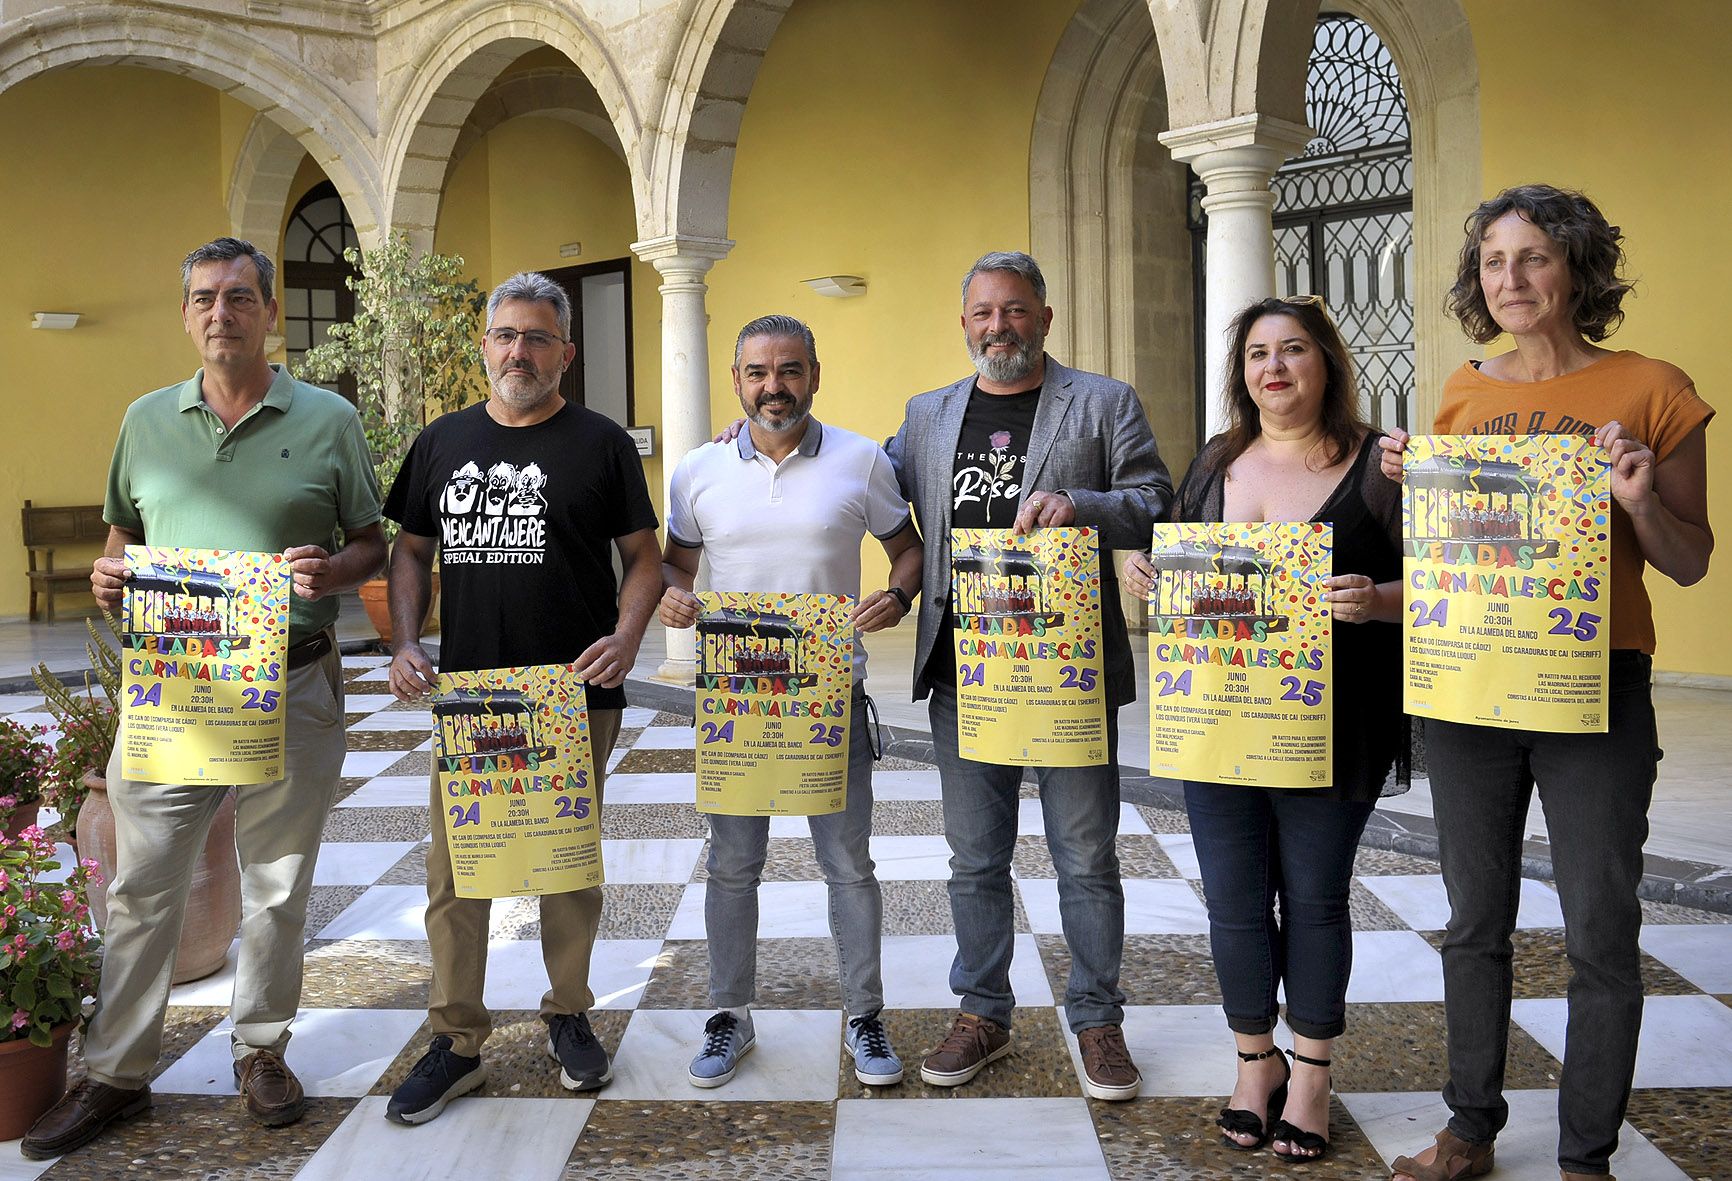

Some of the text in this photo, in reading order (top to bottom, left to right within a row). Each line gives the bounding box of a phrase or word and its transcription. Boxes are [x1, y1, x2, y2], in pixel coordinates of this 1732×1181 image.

[957, 452, 1027, 463] THE ROS
[953, 466, 1022, 510] Rise
[444, 552, 544, 564] SPECIAL EDITION
[1412, 541, 1535, 570] VELADAS
[1410, 569, 1601, 602] CARNAVALESCAS
[1409, 598, 1449, 629] 24
[1487, 602, 1509, 614] JUNIO
[959, 614, 1046, 637] VELADAS
[1157, 618, 1268, 642] VELADAS
[1484, 615, 1512, 626] 20:30H
[1548, 607, 1602, 642] 25
[1477, 627, 1504, 637] ALAMEDA
[1505, 629, 1516, 638] DEL
[1517, 630, 1537, 639] BANCO
[131, 634, 232, 659] VELADAS
[959, 639, 1096, 661] CARNAVALESCAS
[1156, 644, 1324, 671] CARNAVALESCAS
[129, 659, 280, 682] CARNAVALESCAS
[959, 663, 984, 687] 24
[1011, 675, 1033, 683] 20:30H
[1012, 665, 1030, 673] JUNIO
[1060, 665, 1098, 692] 25
[1226, 673, 1246, 682] JUNIO
[193, 685, 211, 694] JUNIO
[704, 676, 800, 696] VELADAS
[1155, 669, 1193, 697] 24
[1224, 684, 1249, 693] 20:30H
[1280, 676, 1326, 707] 25
[127, 683, 162, 707] 24
[241, 687, 280, 713] 25
[1218, 695, 1242, 703] ALAMEDA
[1243, 696, 1253, 704] DEL
[1254, 696, 1271, 705] BANCO
[703, 698, 845, 718] CARNAVALESCAS
[701, 720, 734, 745] 24
[762, 731, 784, 739] 20:30H
[765, 722, 782, 730] JUNIO
[809, 723, 845, 747] 25
[445, 752, 540, 776] VELADAS
[448, 770, 588, 797] CARNAVALESCAS
[449, 801, 480, 828] 24
[507, 808, 530, 818] 20:30H
[508, 799, 526, 808] JUNIO
[554, 796, 592, 819] 25
[503, 819, 524, 827] ALAMEDA
